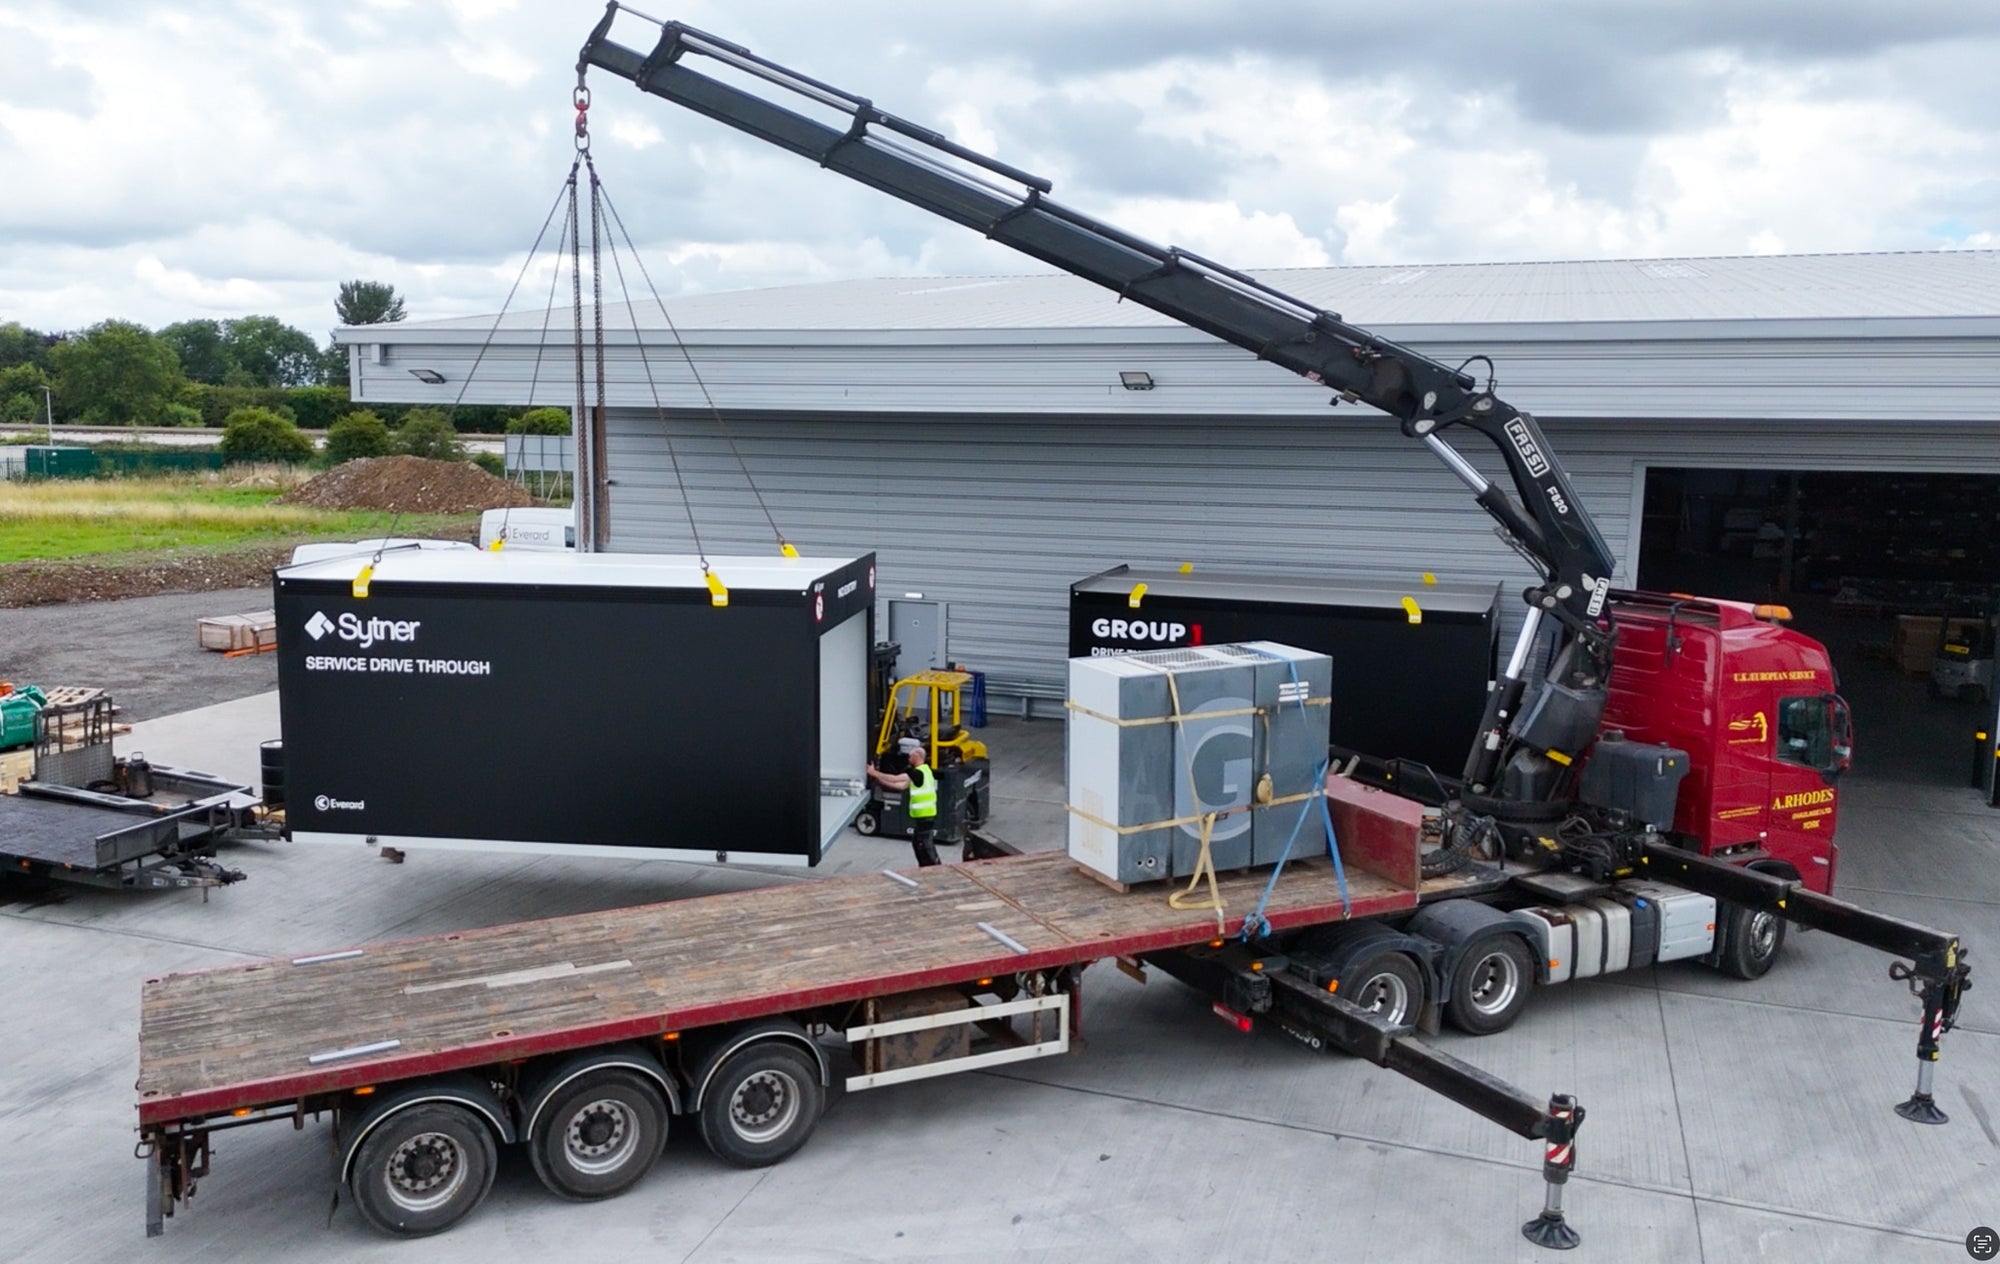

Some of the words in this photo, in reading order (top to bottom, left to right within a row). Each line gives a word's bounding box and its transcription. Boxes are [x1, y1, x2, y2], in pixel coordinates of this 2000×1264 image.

[1510, 423, 1545, 472] FASSI
[512, 527, 550, 540] Everard
[338, 612, 421, 648] Sytner
[1091, 618, 1186, 642] GROUP
[1187, 624, 1202, 647] 1
[305, 656, 367, 671] SERVICE
[369, 658, 413, 672] DRIVE
[415, 659, 490, 674] THROUGH
[330, 798, 365, 810] Everard
[1772, 788, 1834, 810] A.RHODES
